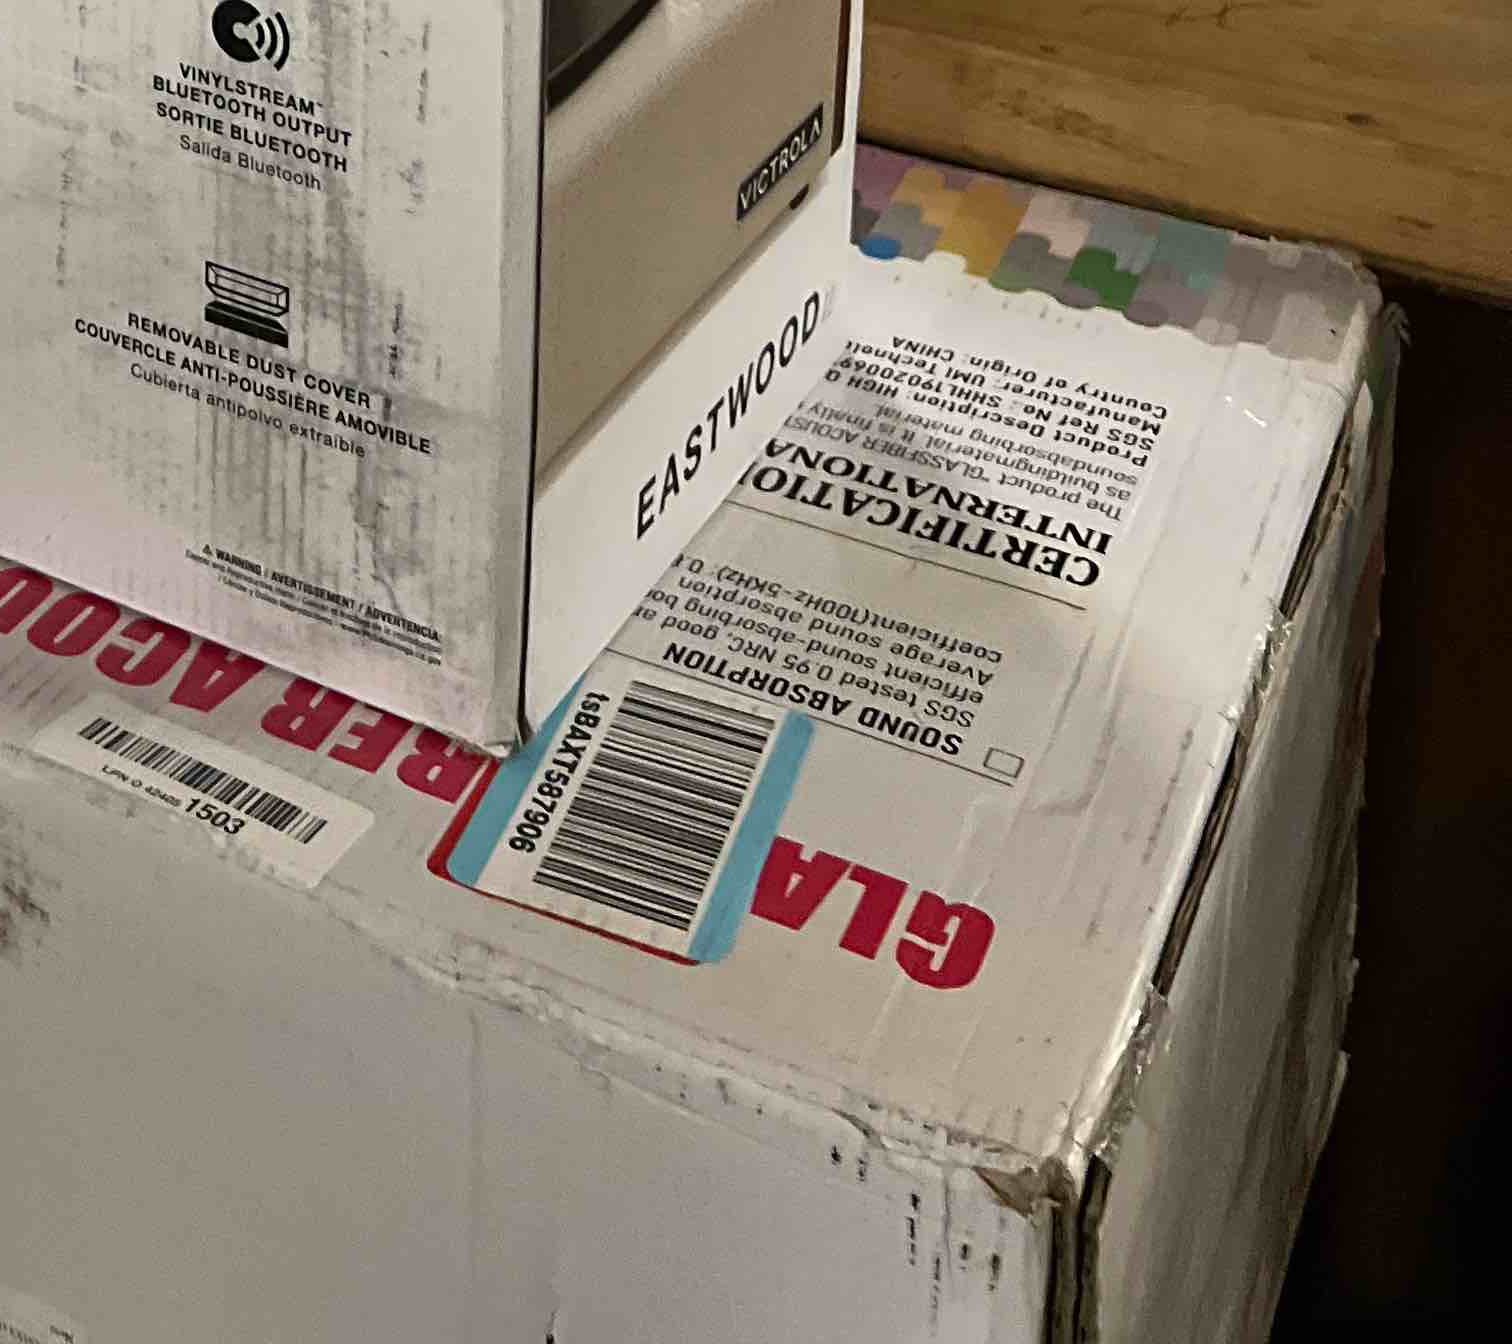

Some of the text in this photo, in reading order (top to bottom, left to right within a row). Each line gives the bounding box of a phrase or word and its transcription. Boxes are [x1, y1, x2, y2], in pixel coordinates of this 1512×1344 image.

[153, 75, 352, 147] BLUETOOTH OUTPUT
[156, 102, 347, 172] SORTIE BLUETOOTH
[179, 135, 321, 191] Salida Bluetooth
[740, 117, 821, 210] VICTROLA
[75, 318, 431, 455] COUVERCLE ANTI-POUSSIÈRE AMOVIBLE
[128, 312, 371, 409] REMOVABLE DUST COVER
[891, 335, 1168, 419] Country of Origin: CHINA
[945, 366, 987, 387] UMI
[130, 362, 200, 402] Cubierta
[206, 393, 283, 430] antipolvo
[848, 376, 899, 398] HIGH
[994, 379, 1161, 435] Manufacturer:
[637, 290, 820, 540] EASTWOOD
[906, 390, 1047, 438] Description:
[1057, 413, 1100, 436] Ref
[1107, 427, 1155, 452] SGS
[968, 427, 1138, 486] soundabsorbing
[1051, 431, 1149, 467] Product
[998, 471, 1082, 506] product
[1087, 498, 1123, 521] The
[1105, 485, 1131, 503] as
[215, 548, 263, 576] WARNING
[271, 571, 356, 610] AVERTISSEMENT
[660, 614, 717, 642] good
[678, 575, 993, 687] Average sound absorption
[684, 594, 877, 670] sound-absorbing
[727, 632, 777, 664] NRC,
[783, 654, 834, 680] 0.95
[838, 672, 917, 708] tested
[883, 663, 983, 705] efficient
[663, 642, 964, 756] SOUND ABSORPTION
[924, 700, 975, 728] SGS
[509, 692, 610, 855] tsBAXT587906
[185, 797, 246, 835] 1503
